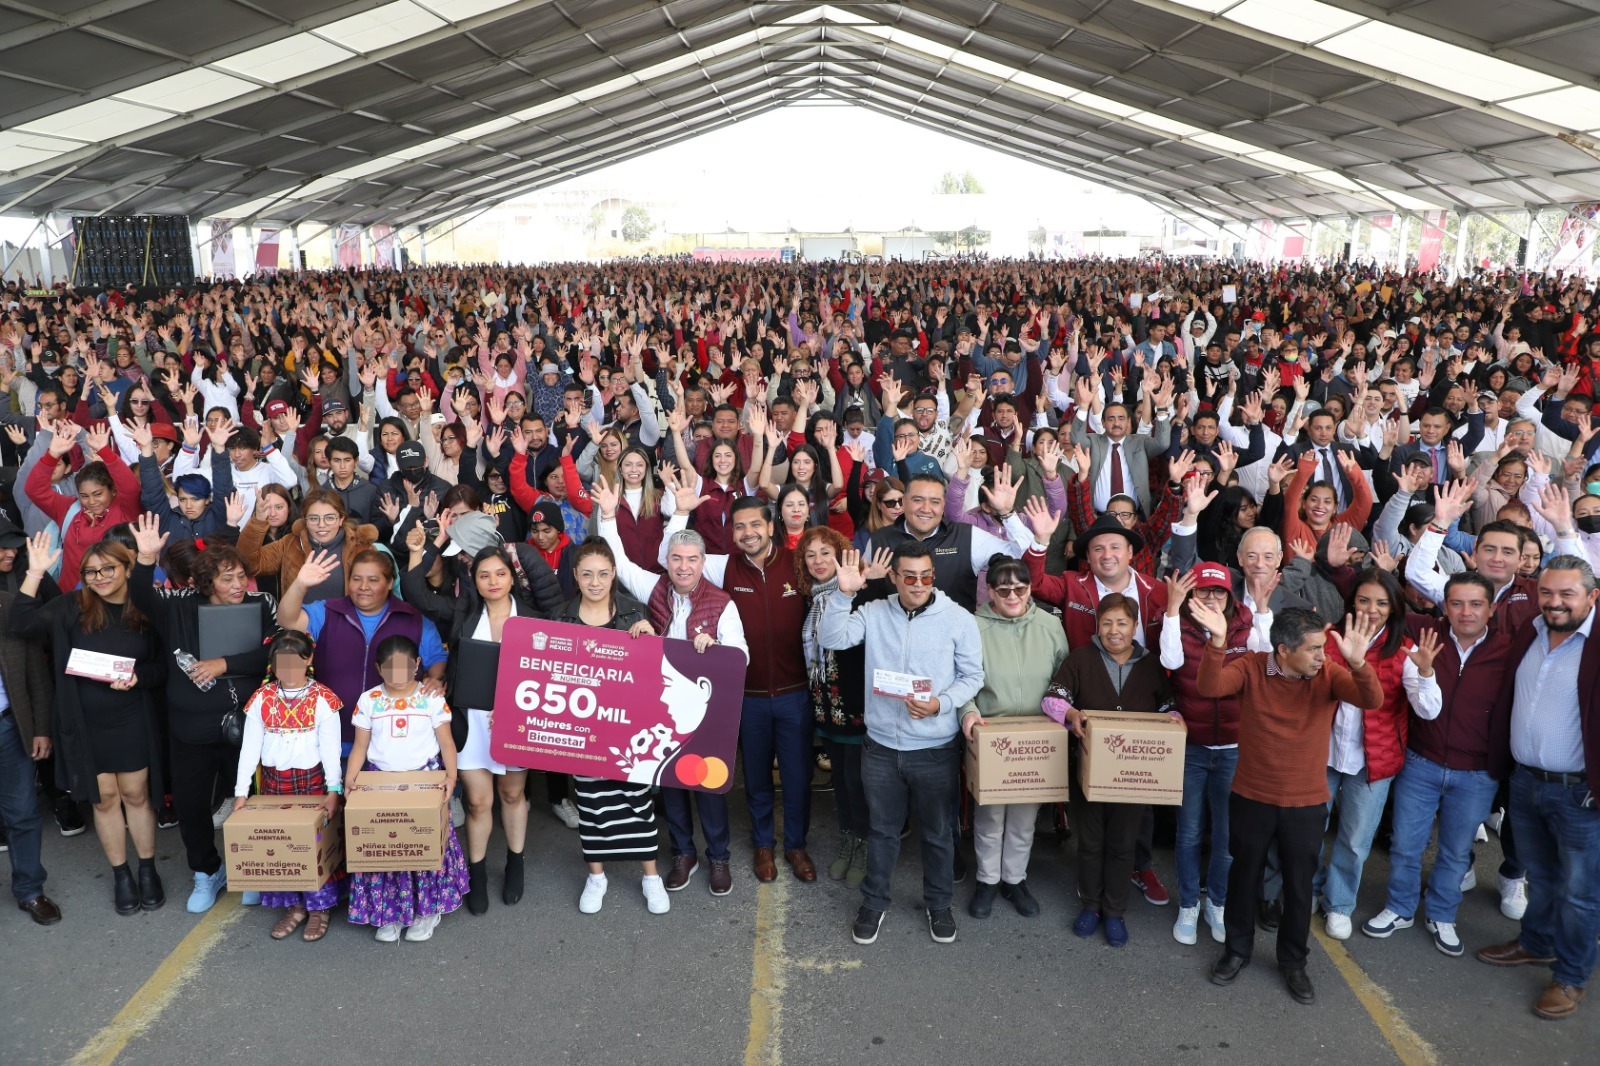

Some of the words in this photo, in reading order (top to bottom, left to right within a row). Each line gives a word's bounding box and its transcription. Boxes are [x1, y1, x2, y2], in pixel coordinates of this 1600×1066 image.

[520, 656, 634, 683] BENEFICIARIA
[560, 675, 592, 685] NÚMERO
[515, 680, 597, 718] 650
[597, 706, 631, 724] MIL
[526, 716, 572, 730] Mujeres
[529, 732, 584, 747] Bienestar
[1008, 746, 1049, 755] MÉXICO
[1122, 745, 1165, 754] MÉXICO
